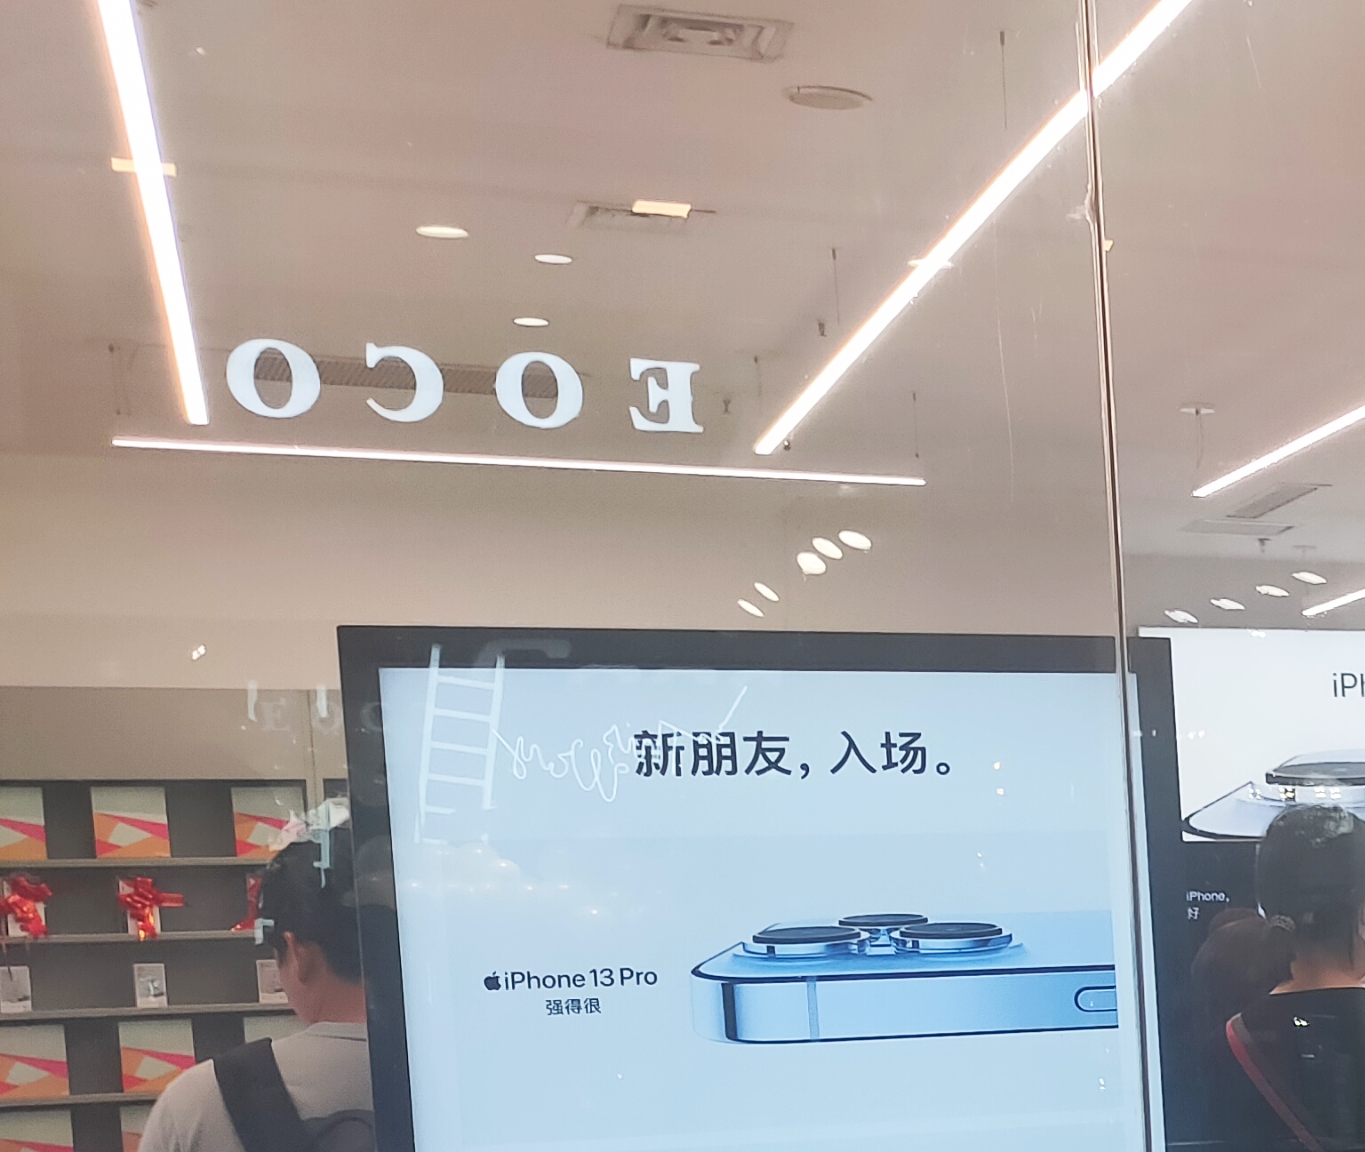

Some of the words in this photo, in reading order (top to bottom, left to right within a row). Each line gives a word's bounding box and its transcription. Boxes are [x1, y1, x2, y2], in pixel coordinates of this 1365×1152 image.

[504, 970, 586, 991] iPhone
[589, 968, 615, 988] 13
[620, 967, 658, 988] Pro
[546, 997, 602, 1016] 强得很
